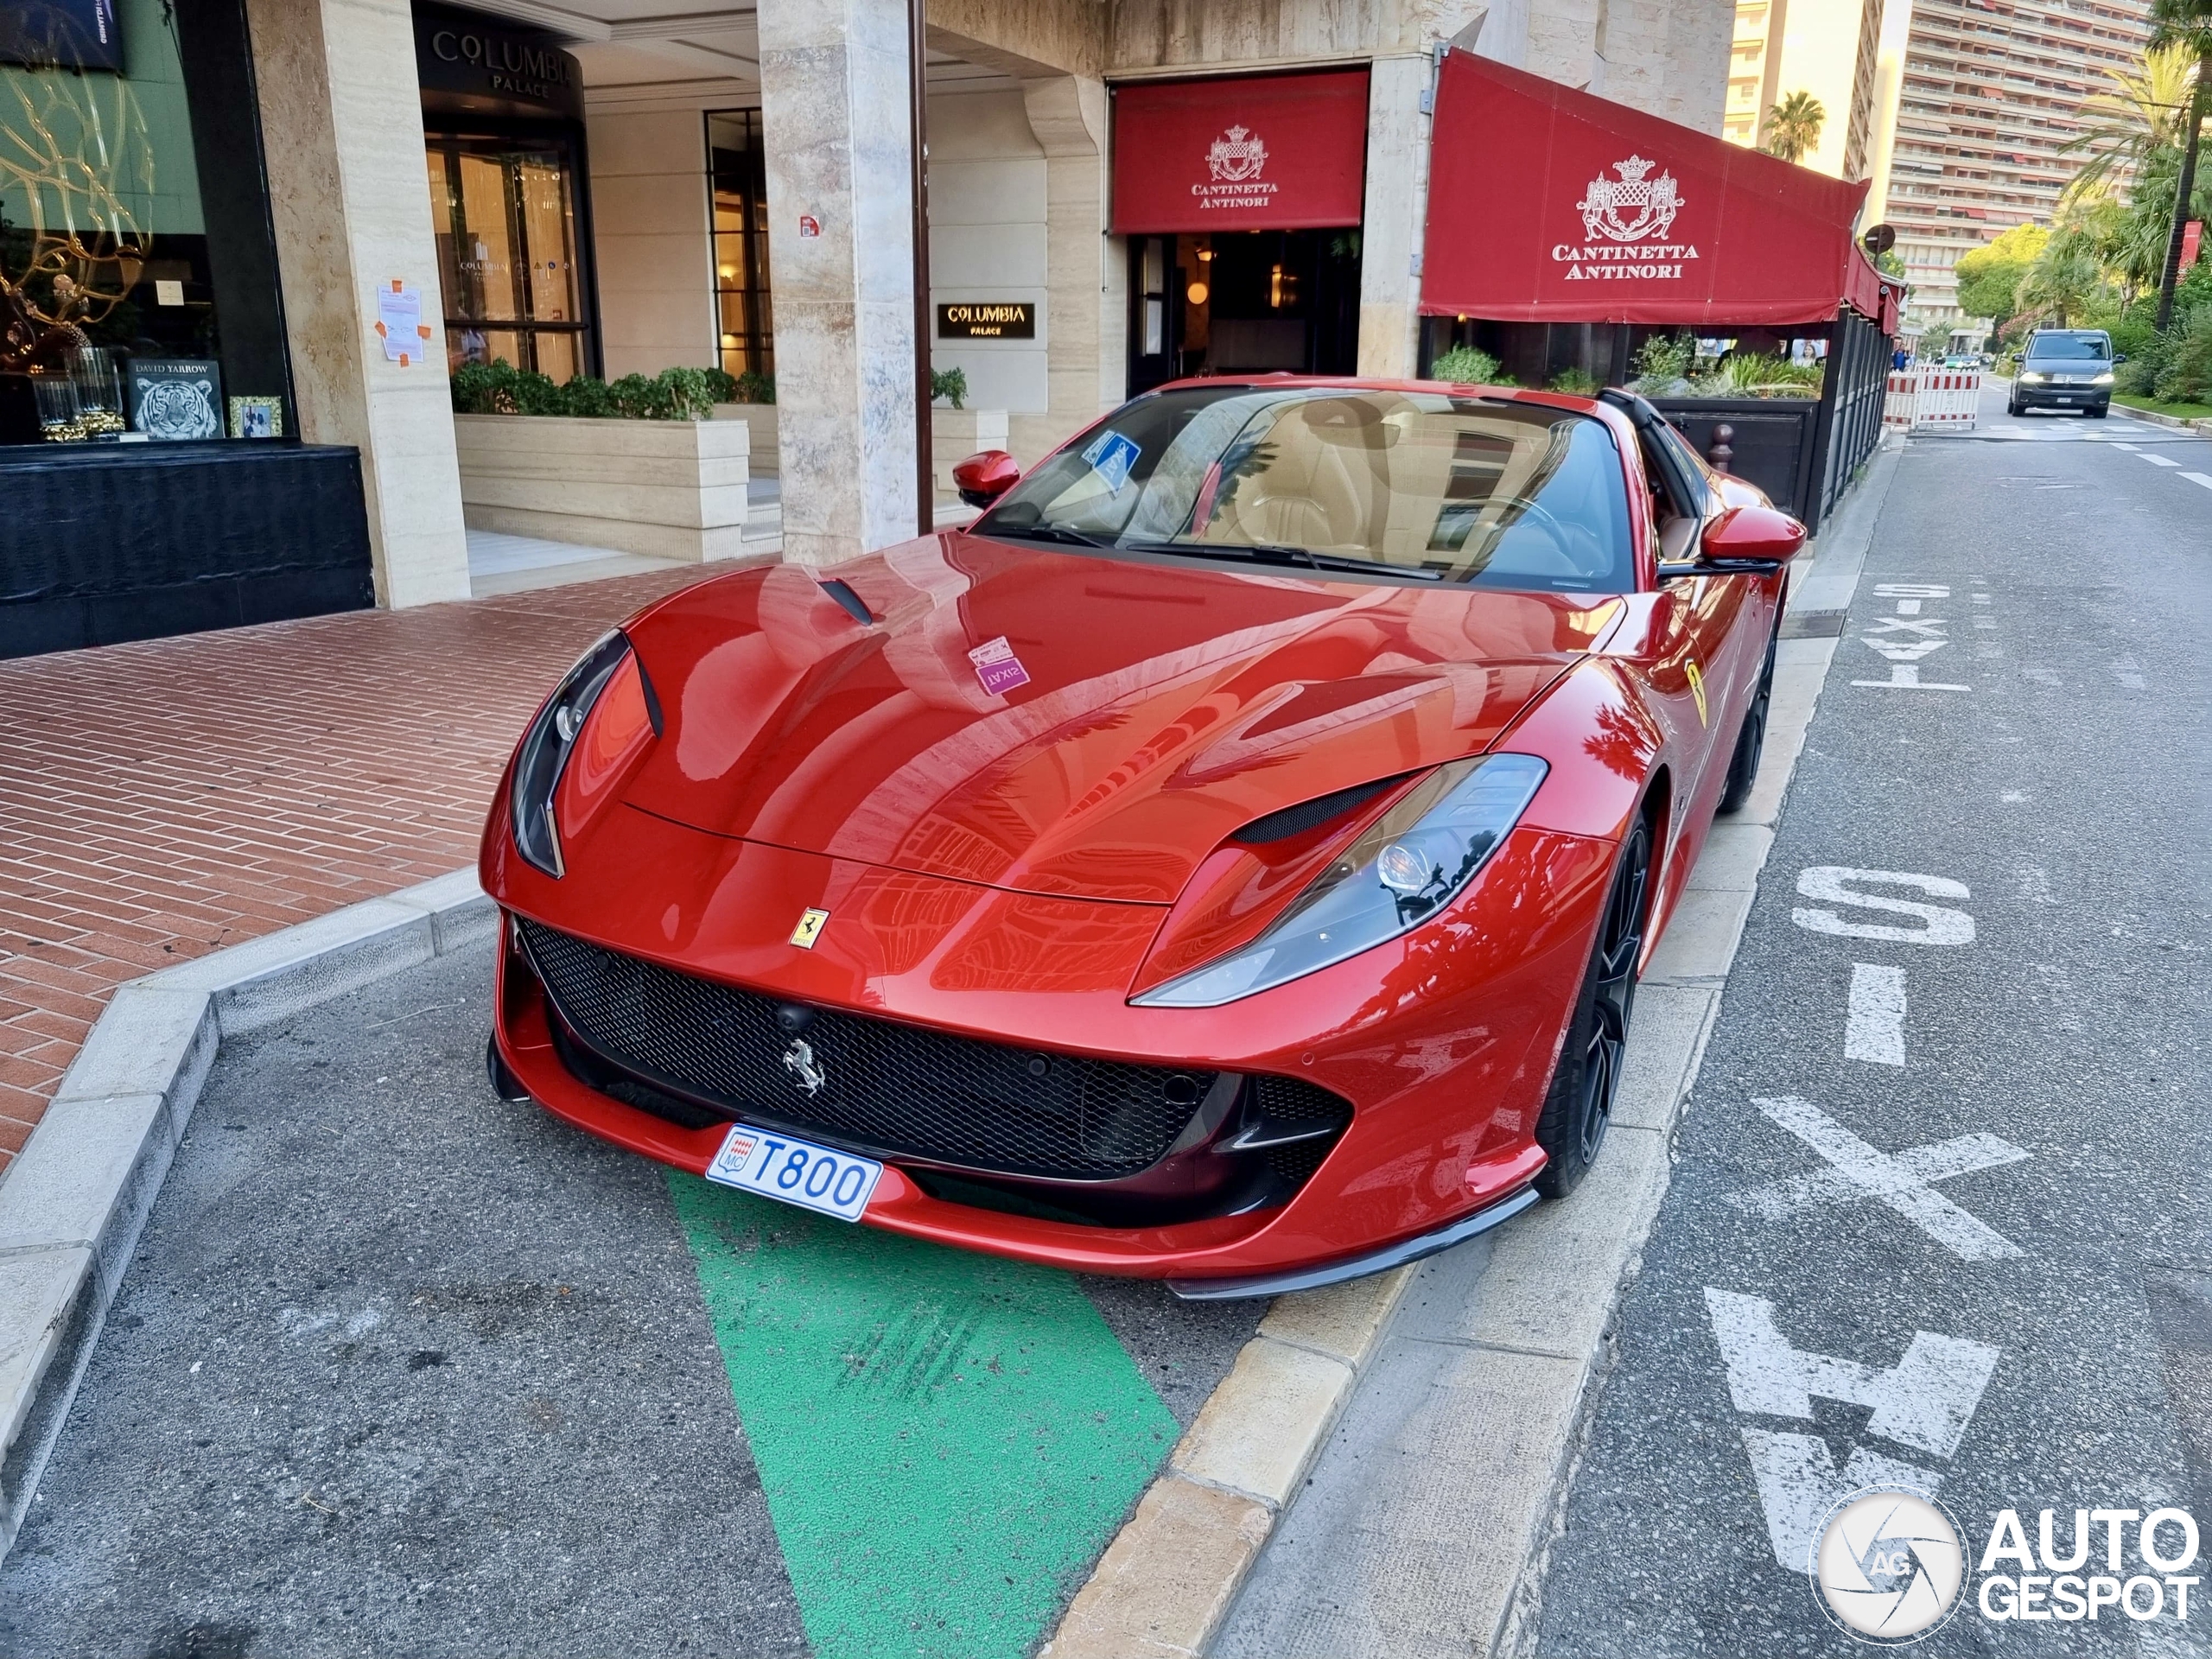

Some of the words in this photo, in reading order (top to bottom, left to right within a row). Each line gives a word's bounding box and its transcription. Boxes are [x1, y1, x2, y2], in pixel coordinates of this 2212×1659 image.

[432, 31, 573, 86] COLUMBIA
[493, 75, 550, 99] PALACE
[1192, 183, 1278, 195] CANTINETTA
[1200, 197, 1269, 208] ANTINORI
[1552, 244, 1700, 262] CANTINETTA
[1564, 264, 1683, 280] ANTINORI
[947, 306, 1025, 322] COLUMBIA
[970, 326, 1001, 335] PALACE
[136, 365, 165, 373] DAVID
[167, 365, 207, 373] YARROW
[724, 1154, 743, 1168] MC
[754, 1139, 867, 1206] T800
